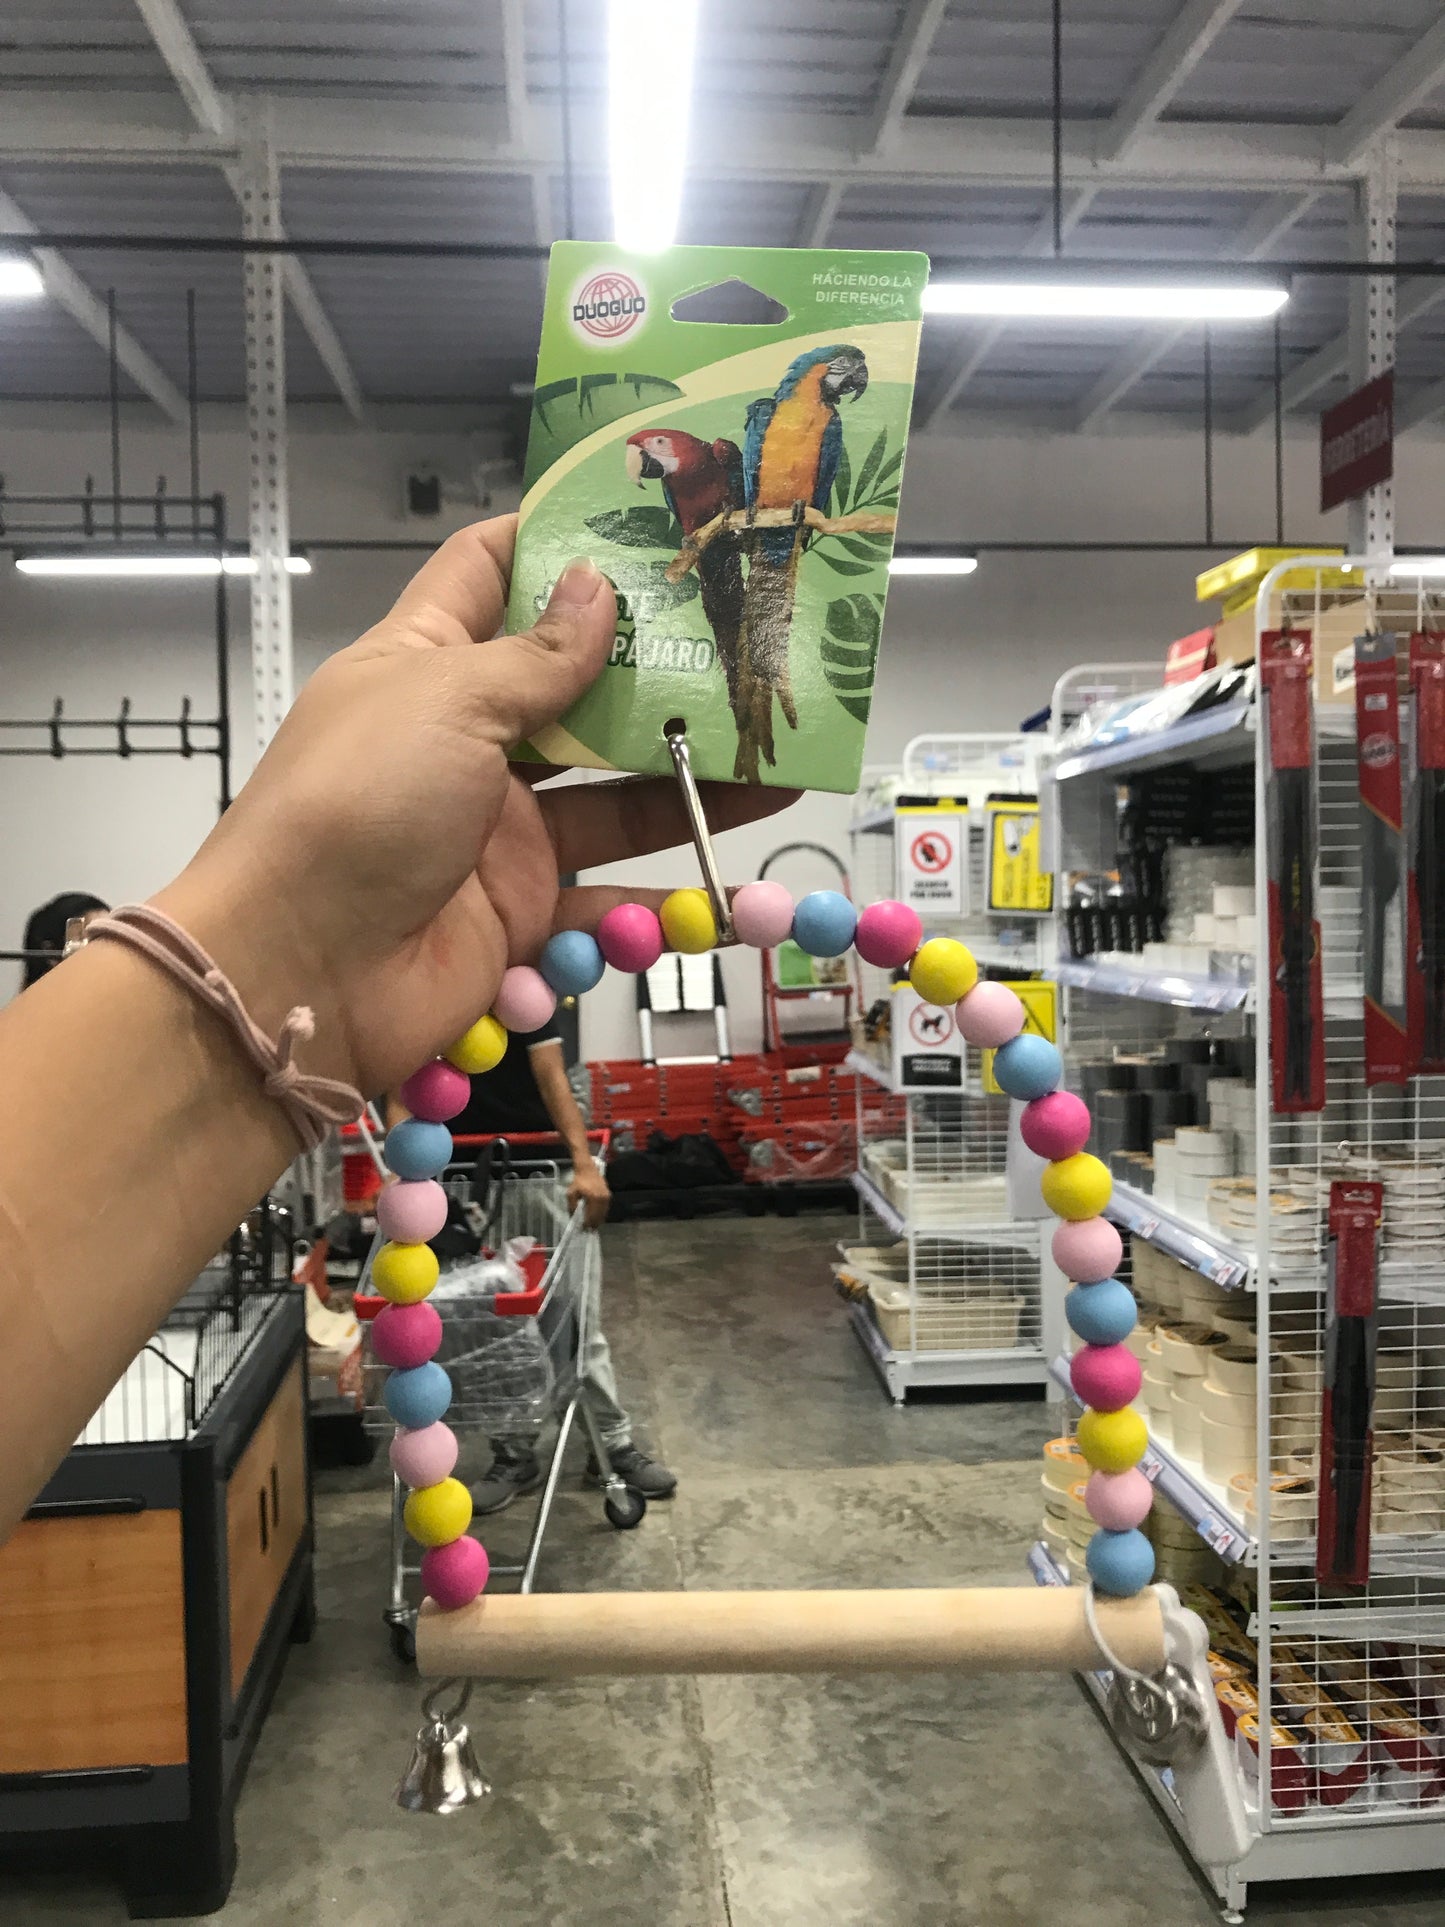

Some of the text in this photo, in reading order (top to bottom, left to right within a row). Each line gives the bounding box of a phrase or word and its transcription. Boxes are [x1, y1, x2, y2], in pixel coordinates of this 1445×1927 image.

[812, 273, 912, 288] HACIENDO LA
[815, 290, 905, 305] DIFERENCIA
[573, 296, 646, 322] DUOGUO
